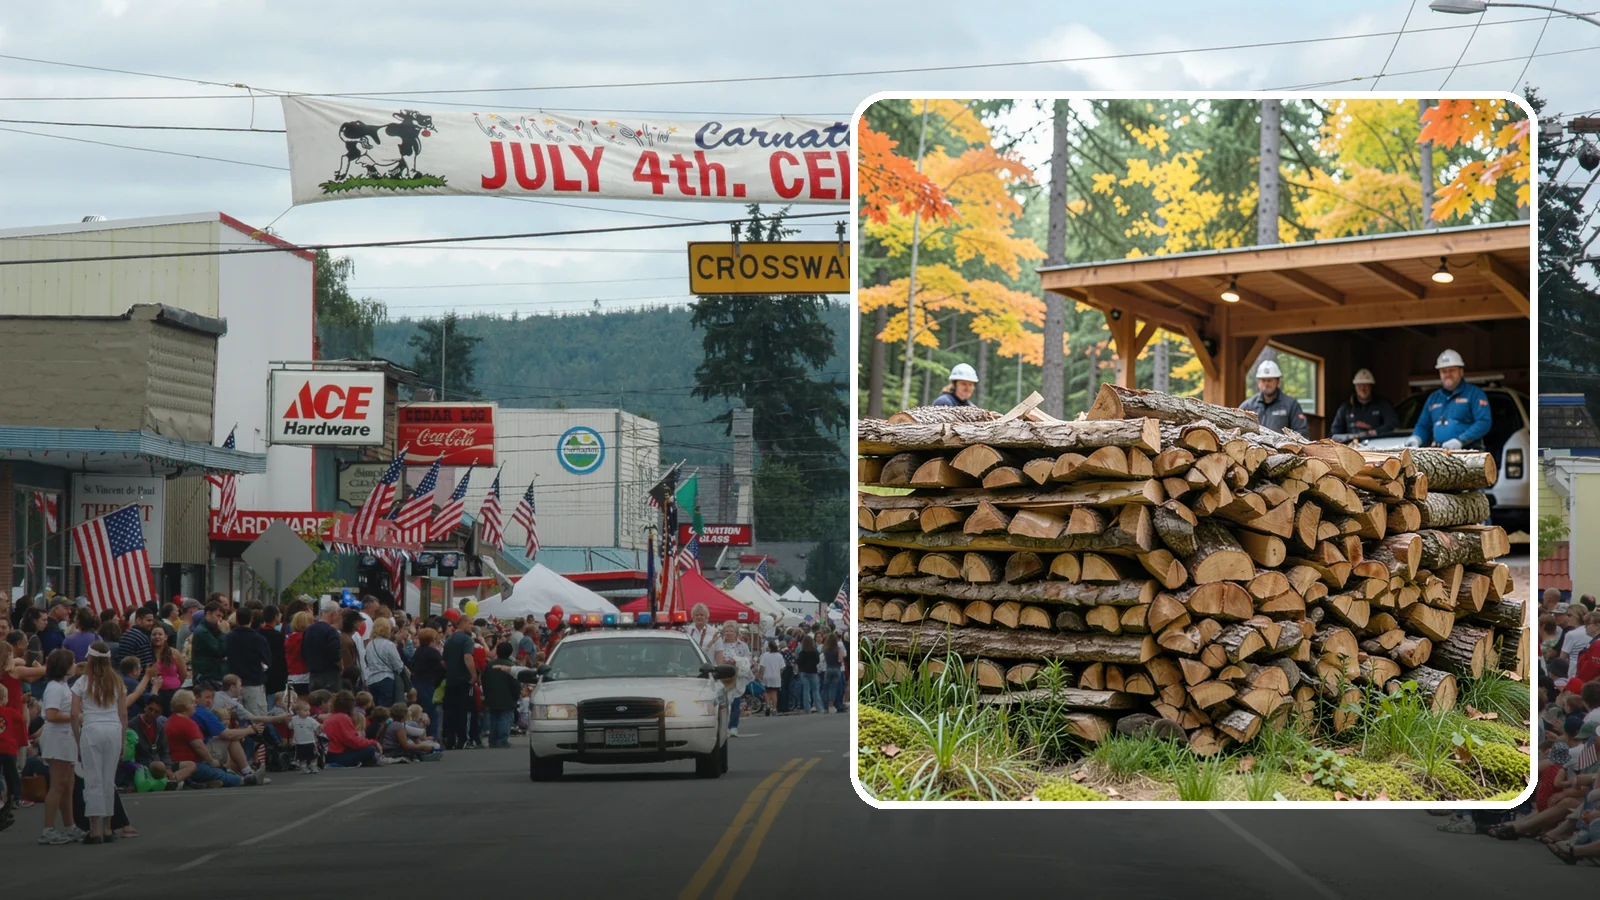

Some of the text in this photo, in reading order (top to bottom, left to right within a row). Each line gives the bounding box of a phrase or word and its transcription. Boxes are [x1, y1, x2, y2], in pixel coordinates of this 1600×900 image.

[695, 121, 850, 150] Carnat
[481, 141, 604, 193] JULY
[633, 150, 746, 197] 4th.
[696, 254, 850, 281] CROSSWA
[283, 380, 373, 420] ACE
[405, 409, 453, 422] CEDAR
[283, 421, 371, 437] Hardware
[416, 428, 477, 447] Coca-Cola
[353, 467, 387, 480] Simpl
[83, 484, 155, 495] St. Vincent de Paul
[688, 526, 741, 535] CRNATION
[699, 535, 730, 543] GLASS
